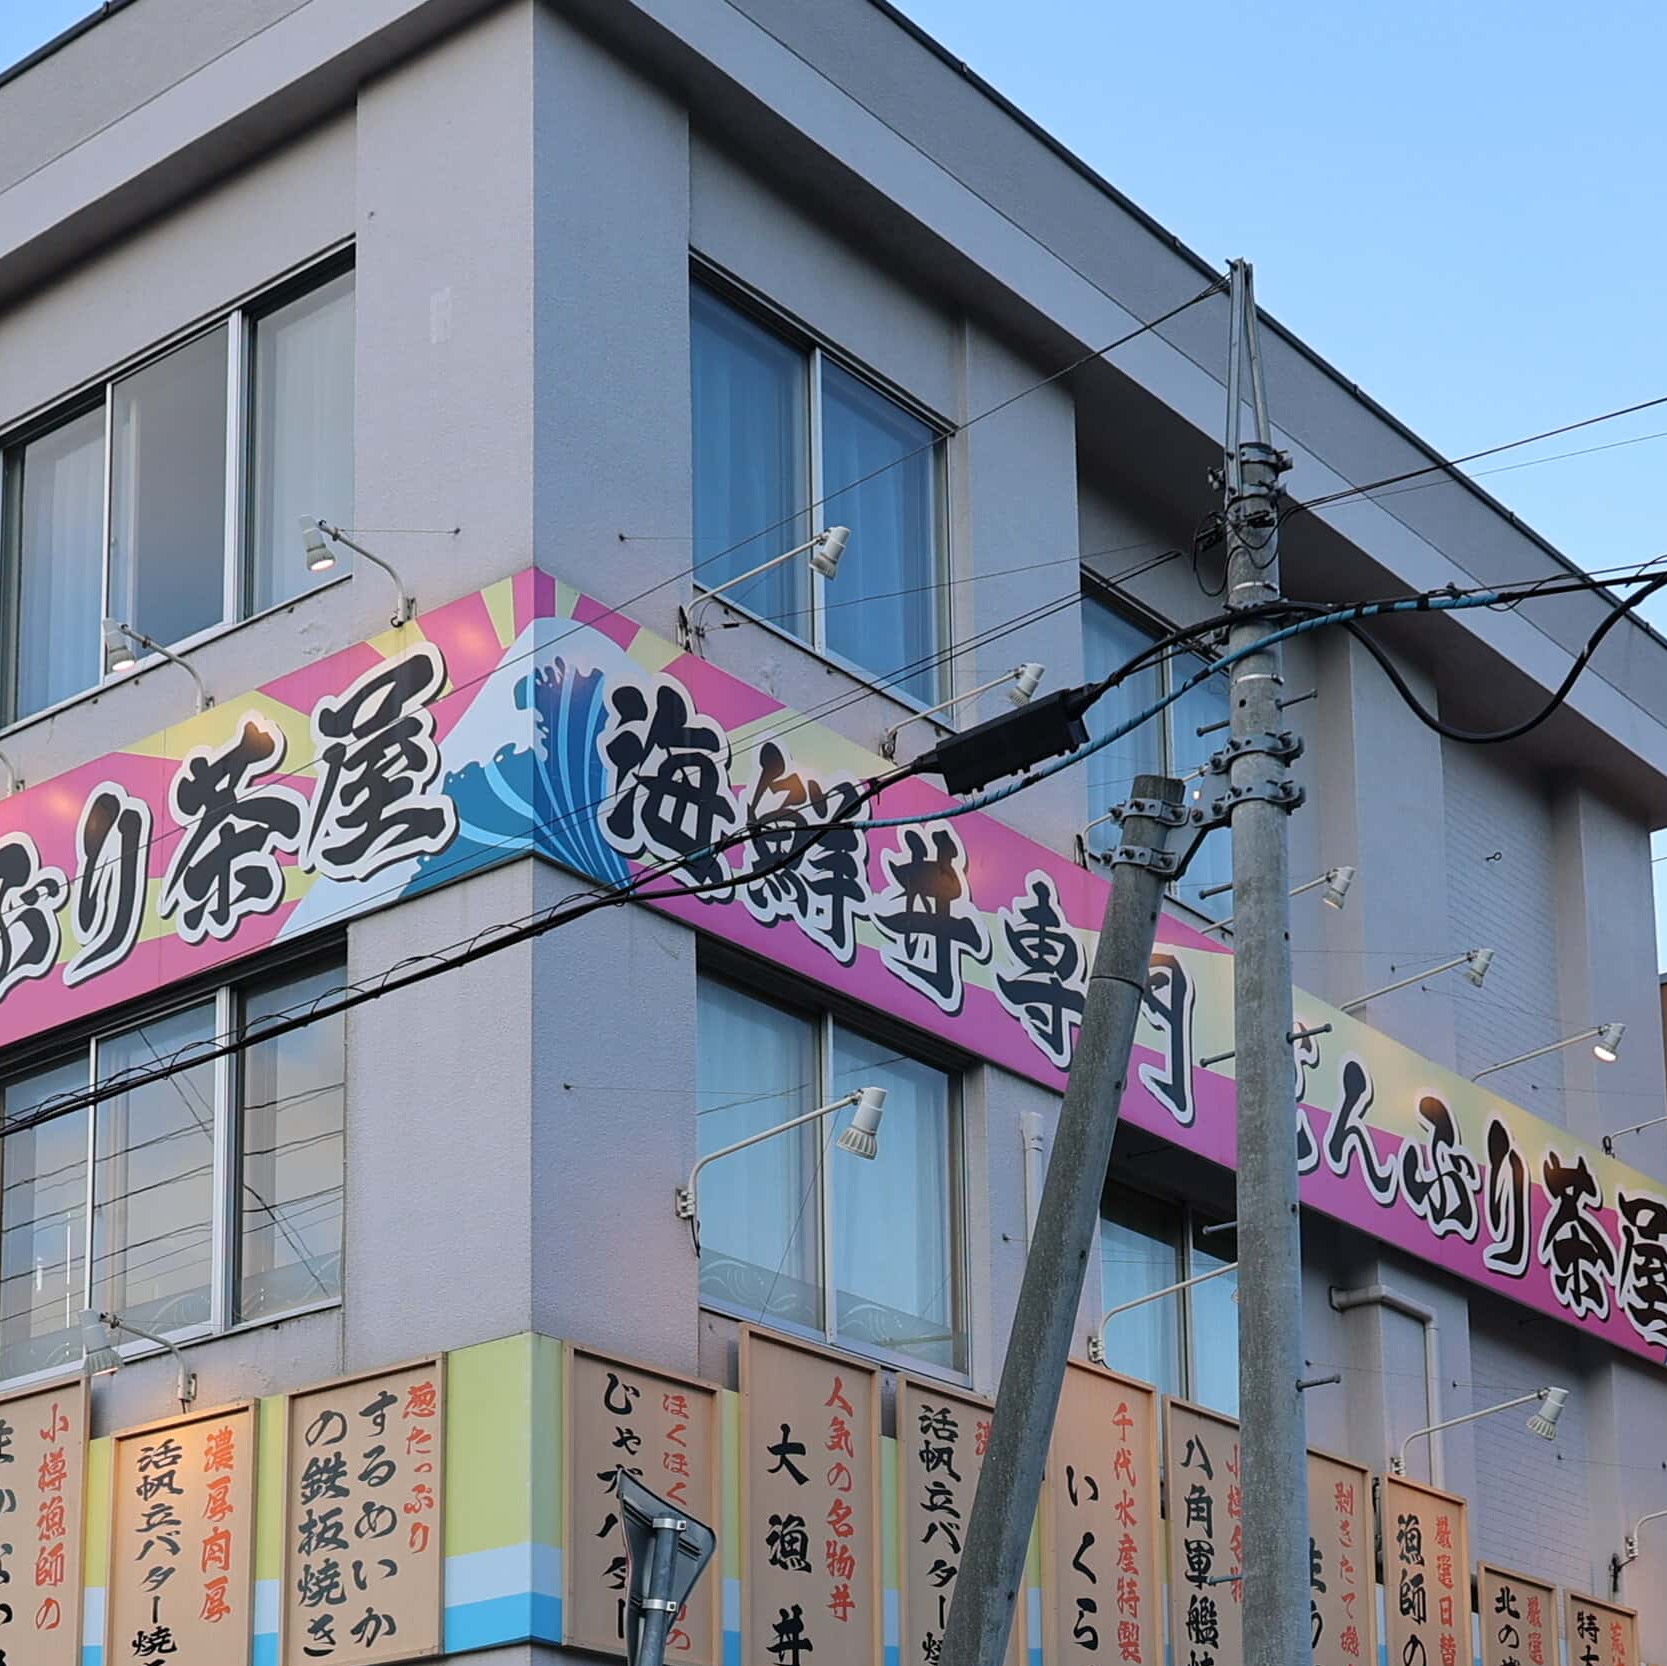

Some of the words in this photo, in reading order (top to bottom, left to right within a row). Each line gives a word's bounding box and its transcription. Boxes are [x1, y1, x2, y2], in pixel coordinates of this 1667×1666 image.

[34, 1402, 71, 1632] 小樽漁師の
[197, 1425, 236, 1623] 濃厚肉厚
[297, 1411, 351, 1657] の鉄板焼き
[349, 1389, 398, 1649] するめいか
[402, 1382, 437, 1554] 葱たっぷり
[823, 1376, 856, 1623] 人気の名物丼
[1111, 1402, 1142, 1664] 千代水産特製
